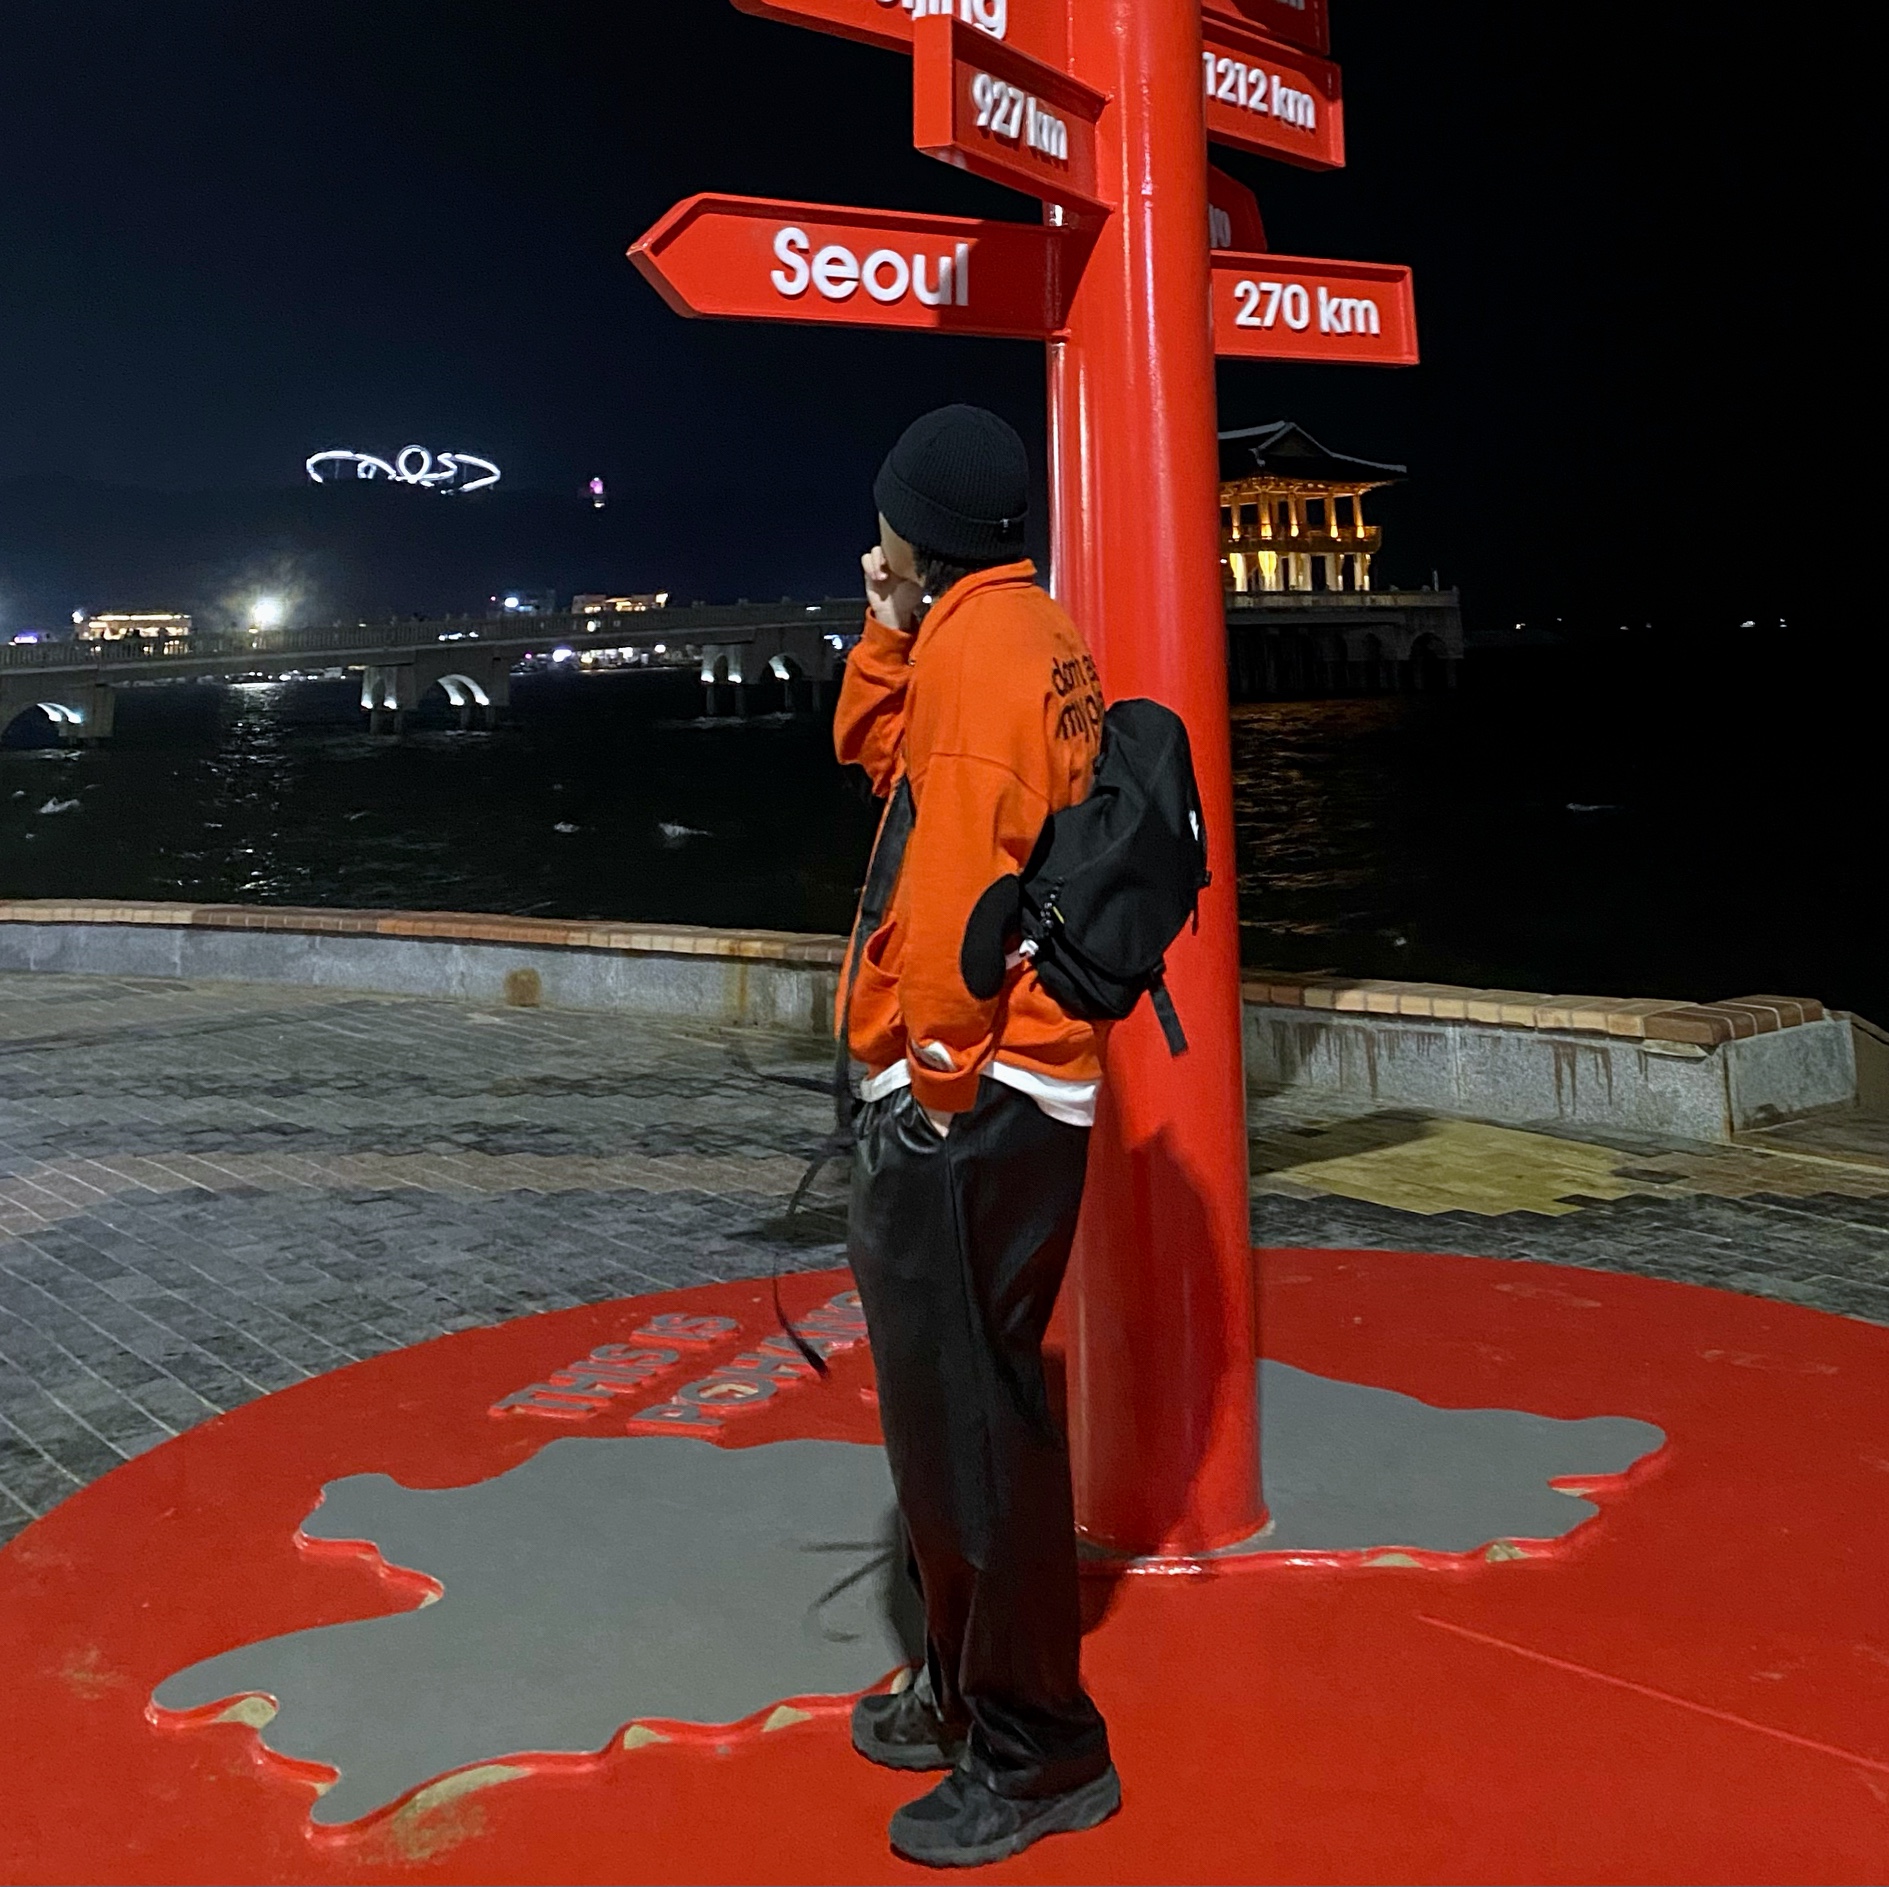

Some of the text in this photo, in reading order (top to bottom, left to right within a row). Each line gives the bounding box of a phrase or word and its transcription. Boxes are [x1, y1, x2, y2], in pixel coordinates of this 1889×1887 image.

[972, 73, 1068, 160] 927 km
[1202, 51, 1316, 130] 1212 km
[771, 226, 969, 306] Seoul
[1234, 280, 1380, 335] 270 km
[488, 1312, 741, 1416] THIS IS
